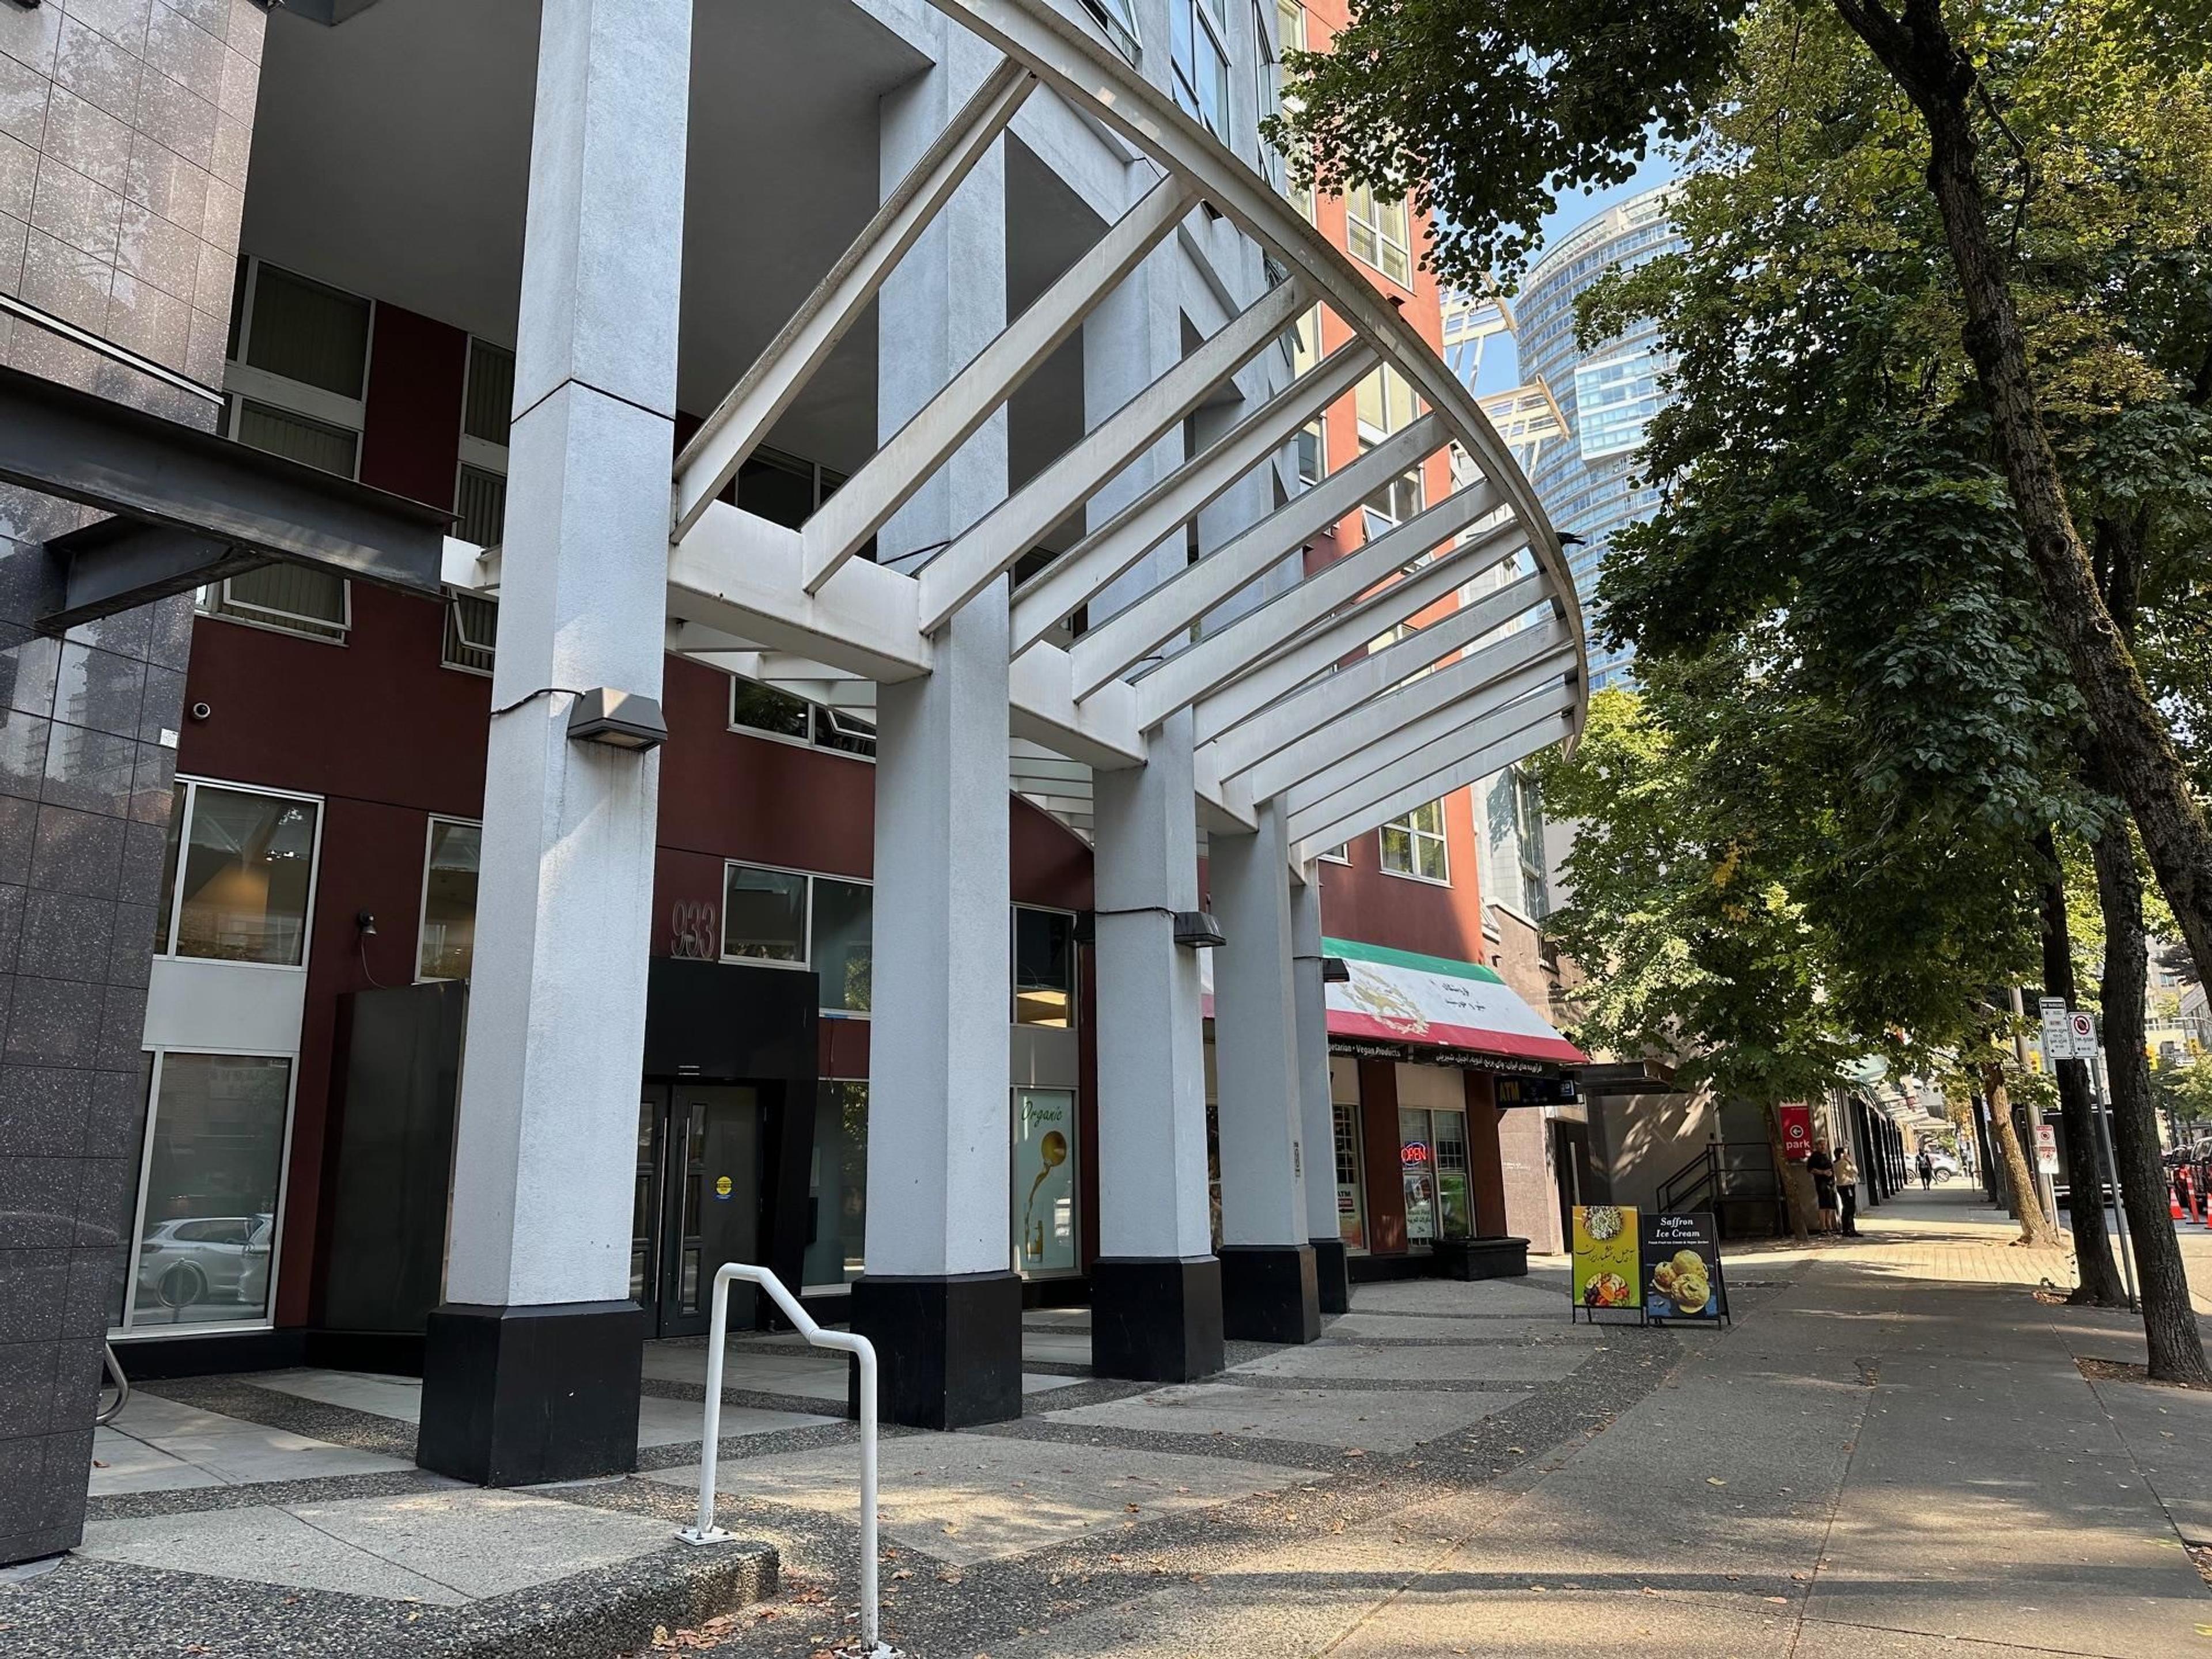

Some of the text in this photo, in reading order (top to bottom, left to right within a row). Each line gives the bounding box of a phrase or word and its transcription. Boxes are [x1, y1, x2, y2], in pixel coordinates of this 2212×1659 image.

[671, 901, 715, 957] 933
[1356, 1044, 1374, 1055] Vegan
[1375, 1047, 1401, 1057] Products
[1499, 1081, 1520, 1102] ATM
[1021, 1100, 1063, 1127] Organic
[1786, 1139, 1810, 1150] park
[1401, 1147, 1427, 1161] OPEN
[1660, 1217, 1694, 1228] Saffron
[1656, 1229, 1700, 1237] Ice Cream
